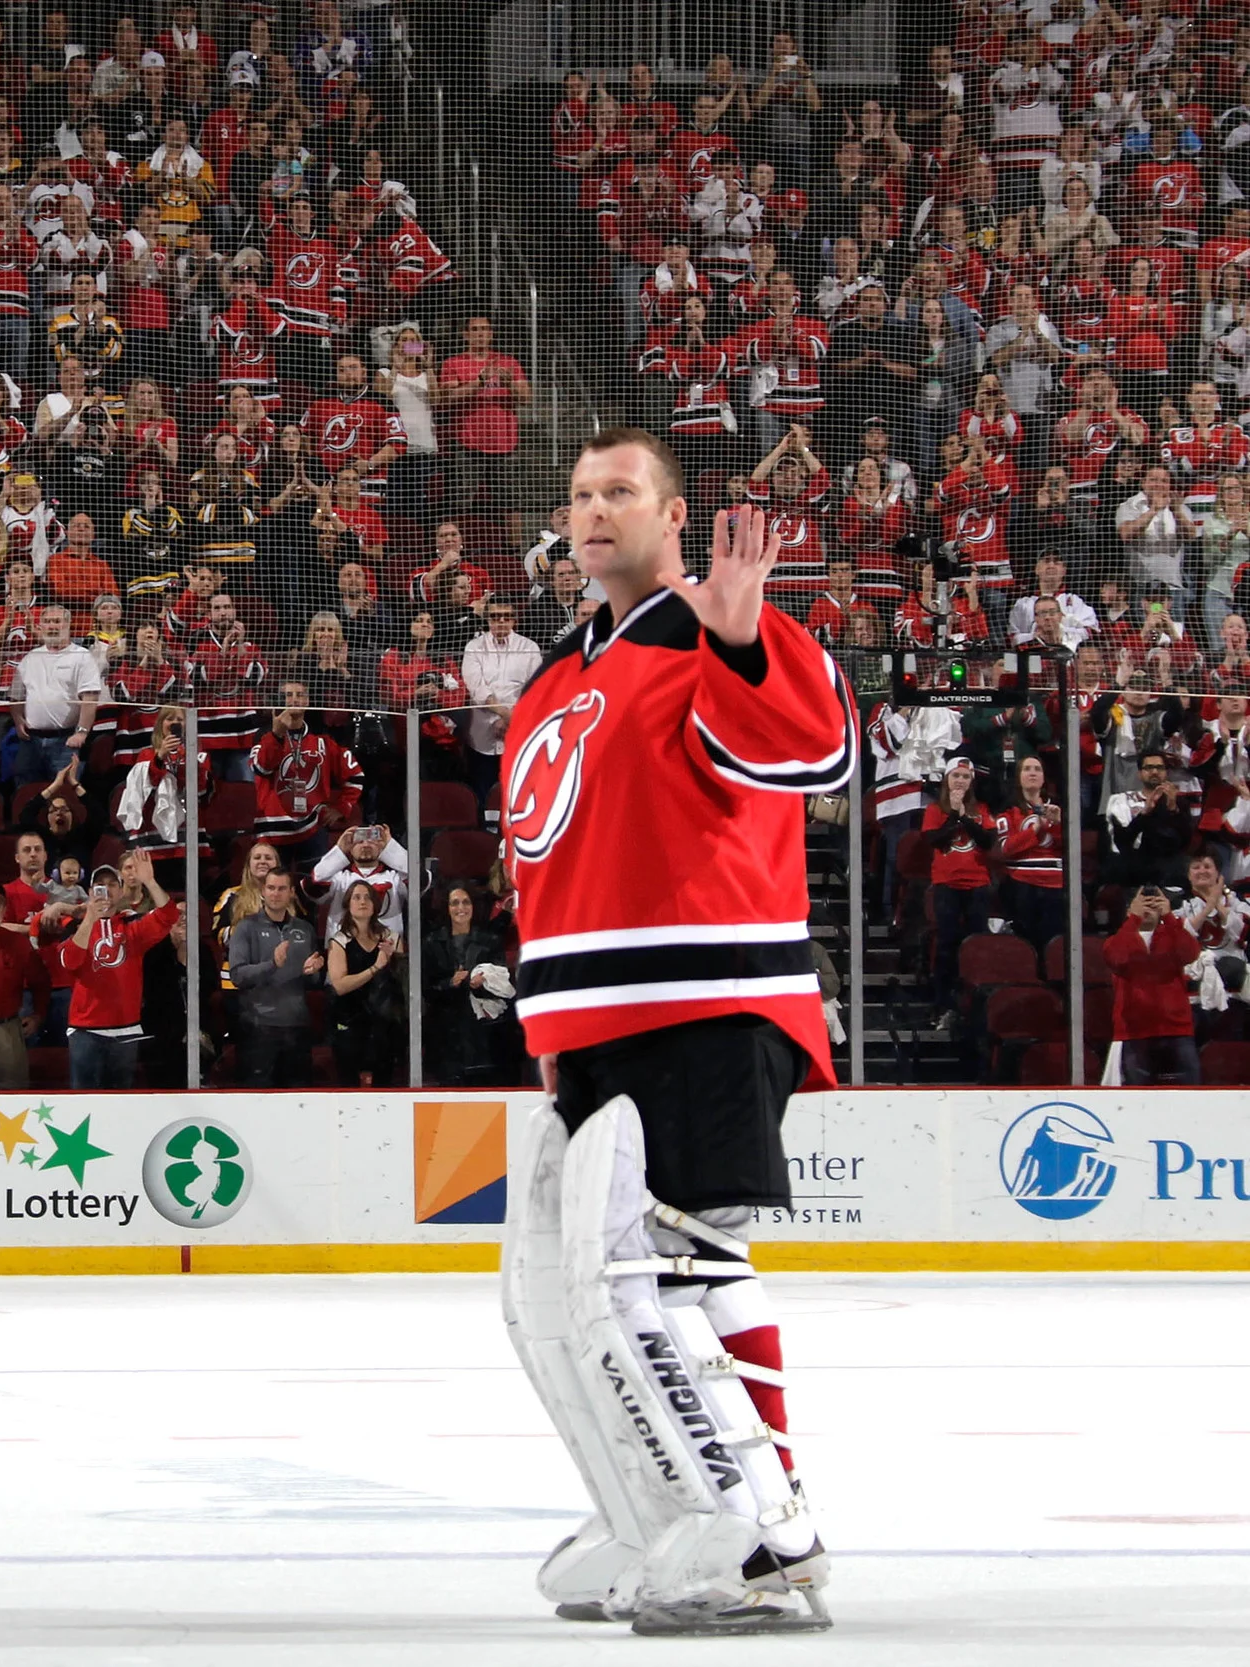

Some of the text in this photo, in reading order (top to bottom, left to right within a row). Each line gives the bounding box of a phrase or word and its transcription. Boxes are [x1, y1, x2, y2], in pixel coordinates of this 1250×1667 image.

[389, 233, 417, 256] 23
[386, 416, 406, 434] 3
[929, 695, 993, 703] DAKTRONICS
[6, 1188, 139, 1226] Lottery
[772, 1208, 862, 1224] SYSTEM
[601, 1351, 680, 1482] VAUGHN
[636, 1331, 744, 1493] VAUGHN
